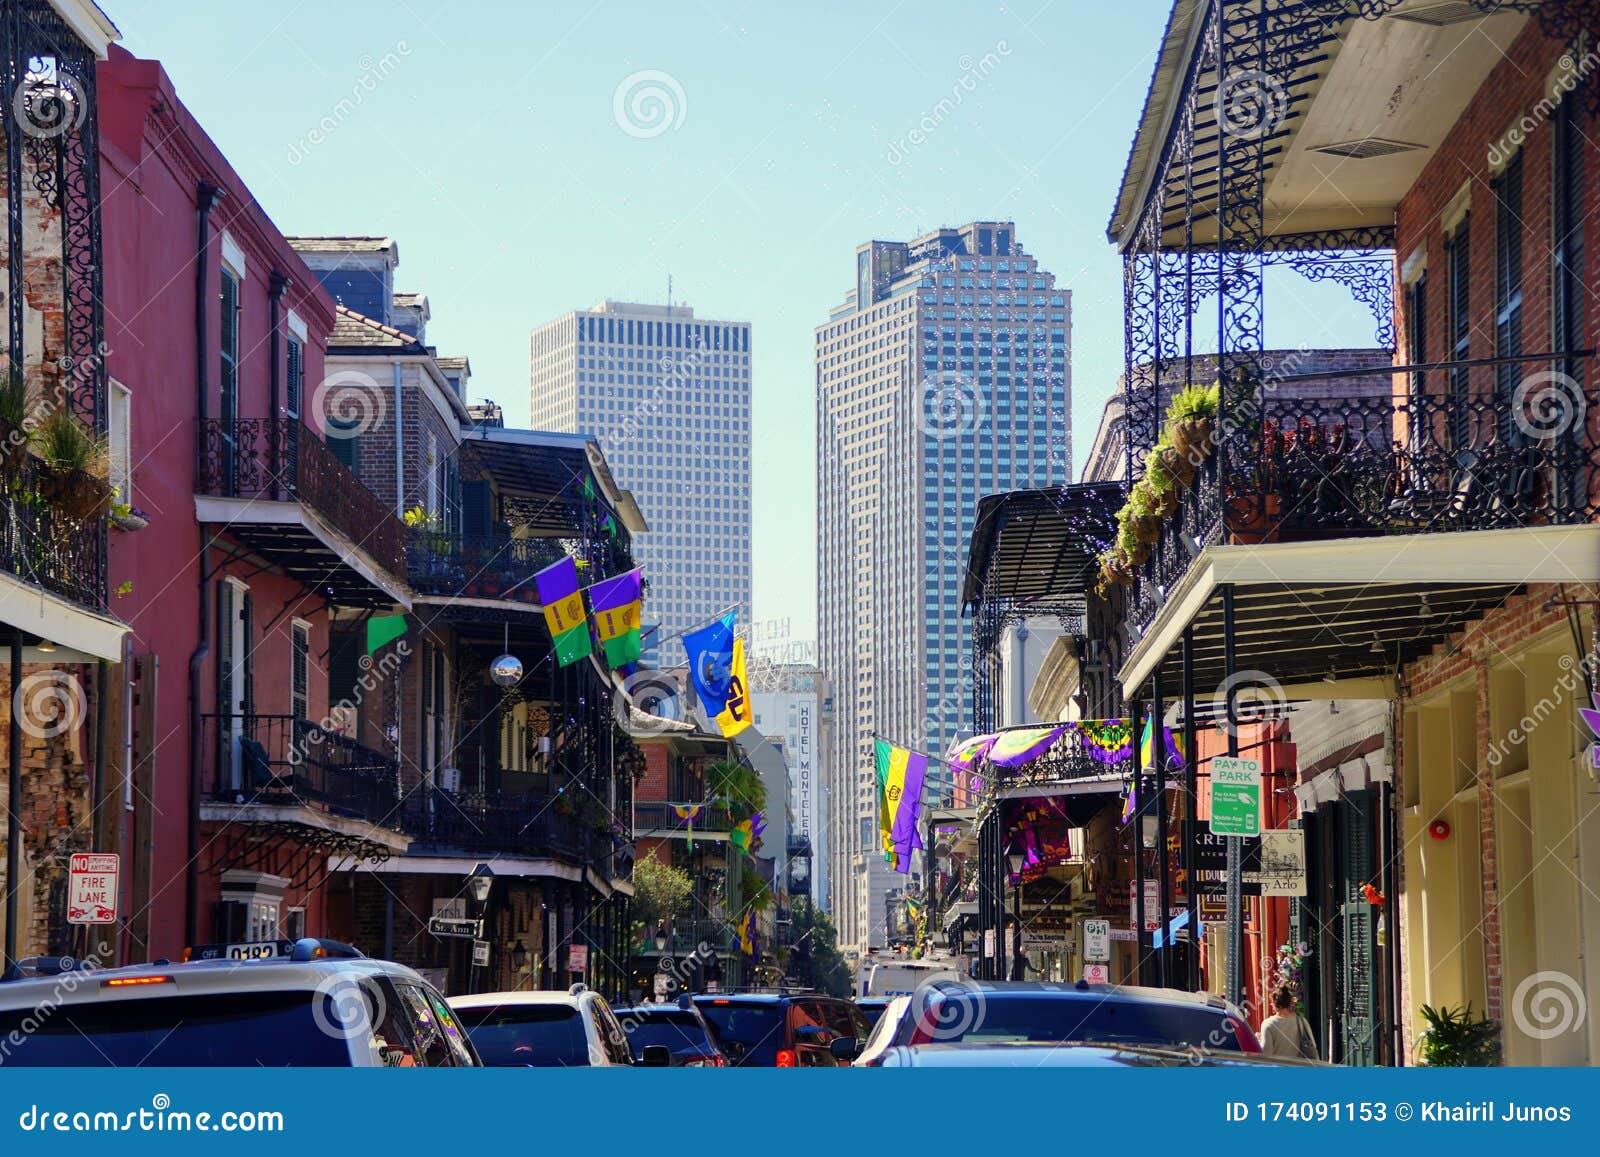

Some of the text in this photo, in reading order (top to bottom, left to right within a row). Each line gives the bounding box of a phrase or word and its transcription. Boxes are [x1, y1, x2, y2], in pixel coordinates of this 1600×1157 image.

[801, 707, 809, 754] HOTEL
[1214, 760, 1256, 771] PAY TO
[1219, 771, 1252, 781] PARK
[73, 858, 88, 871] NO
[82, 877, 106, 888] FIRE
[1273, 880, 1298, 889] Arlo
[79, 892, 107, 903] LANE
[450, 924, 469, 933] Ann
[201, 950, 218, 959] OFF
